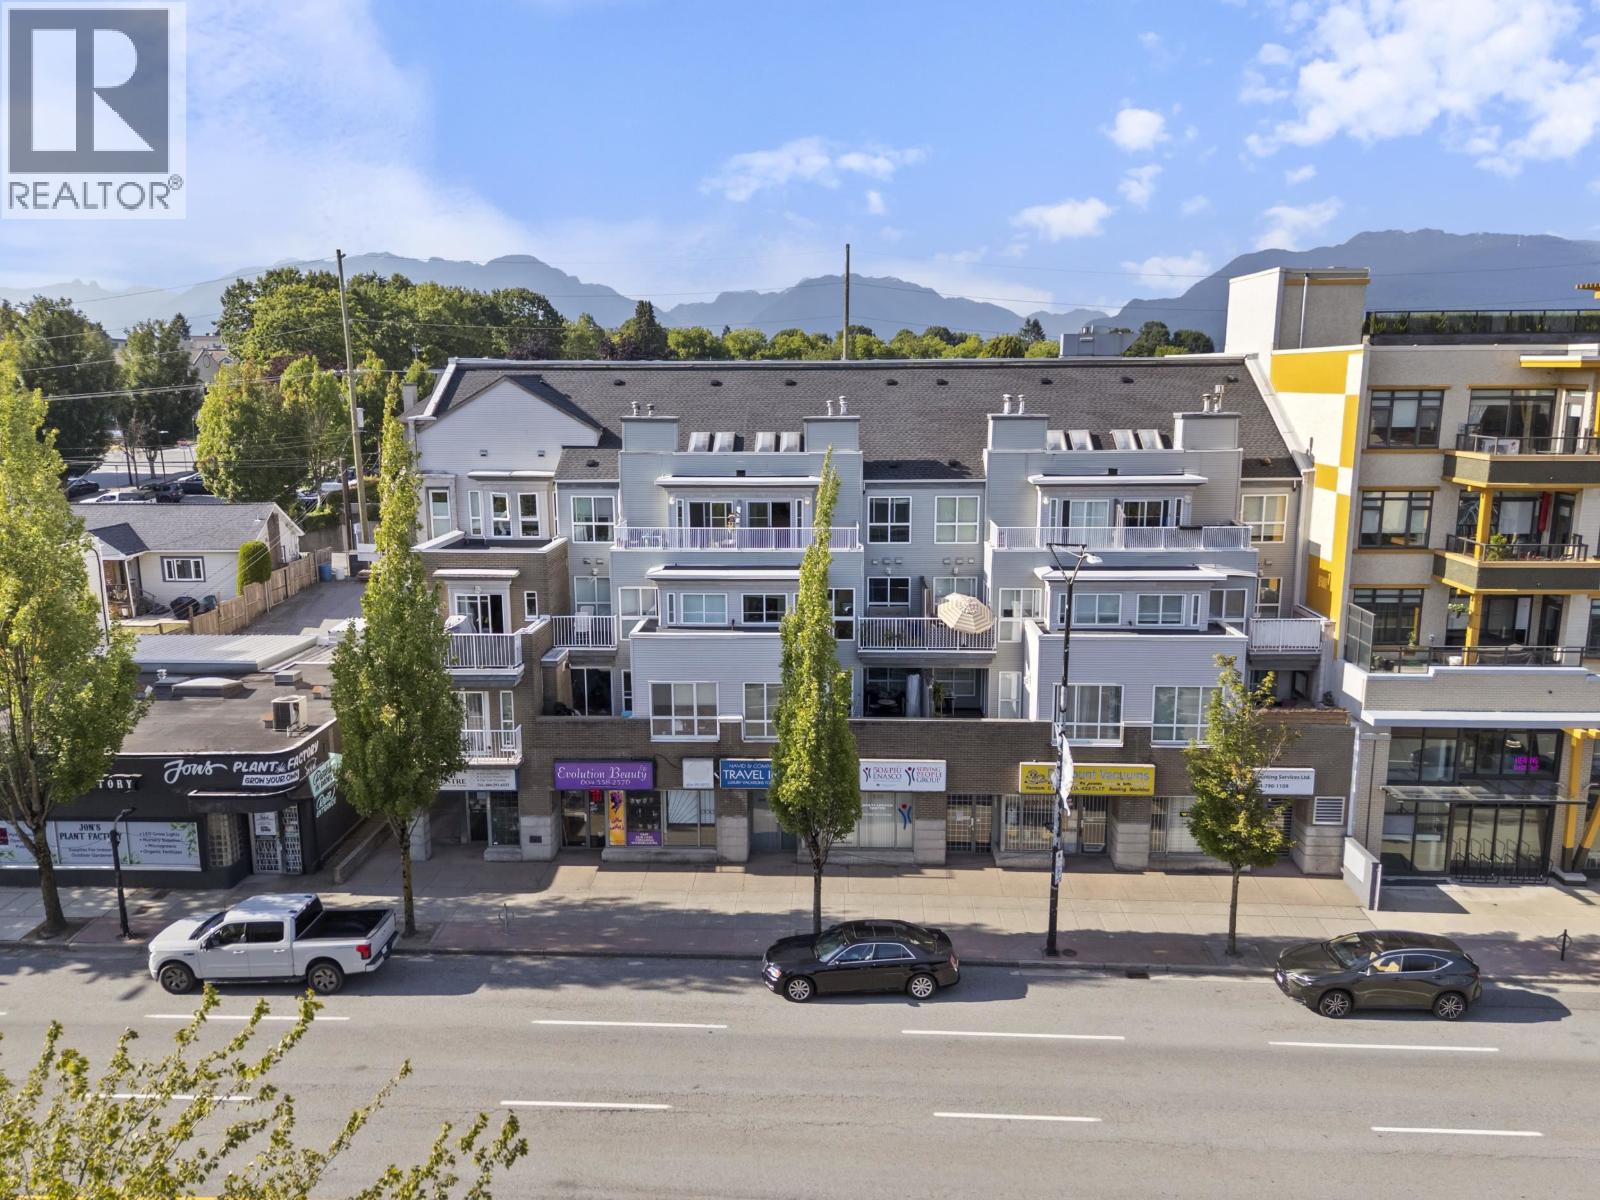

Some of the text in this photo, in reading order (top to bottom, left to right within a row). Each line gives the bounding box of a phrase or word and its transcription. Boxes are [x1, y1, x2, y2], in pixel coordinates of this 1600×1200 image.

[233, 761, 278, 773] PLANT
[287, 740, 319, 770] FACTORY
[245, 770, 299, 785] GROW YOUR OWN
[557, 766, 647, 781] Evolution Beauty
[723, 770, 764, 780] TRAVEL
[1099, 768, 1150, 781] Vacuums
[96, 779, 132, 789] TORY
[79, 823, 101, 831] JON'S
[60, 832, 121, 840] PLANT FACT
